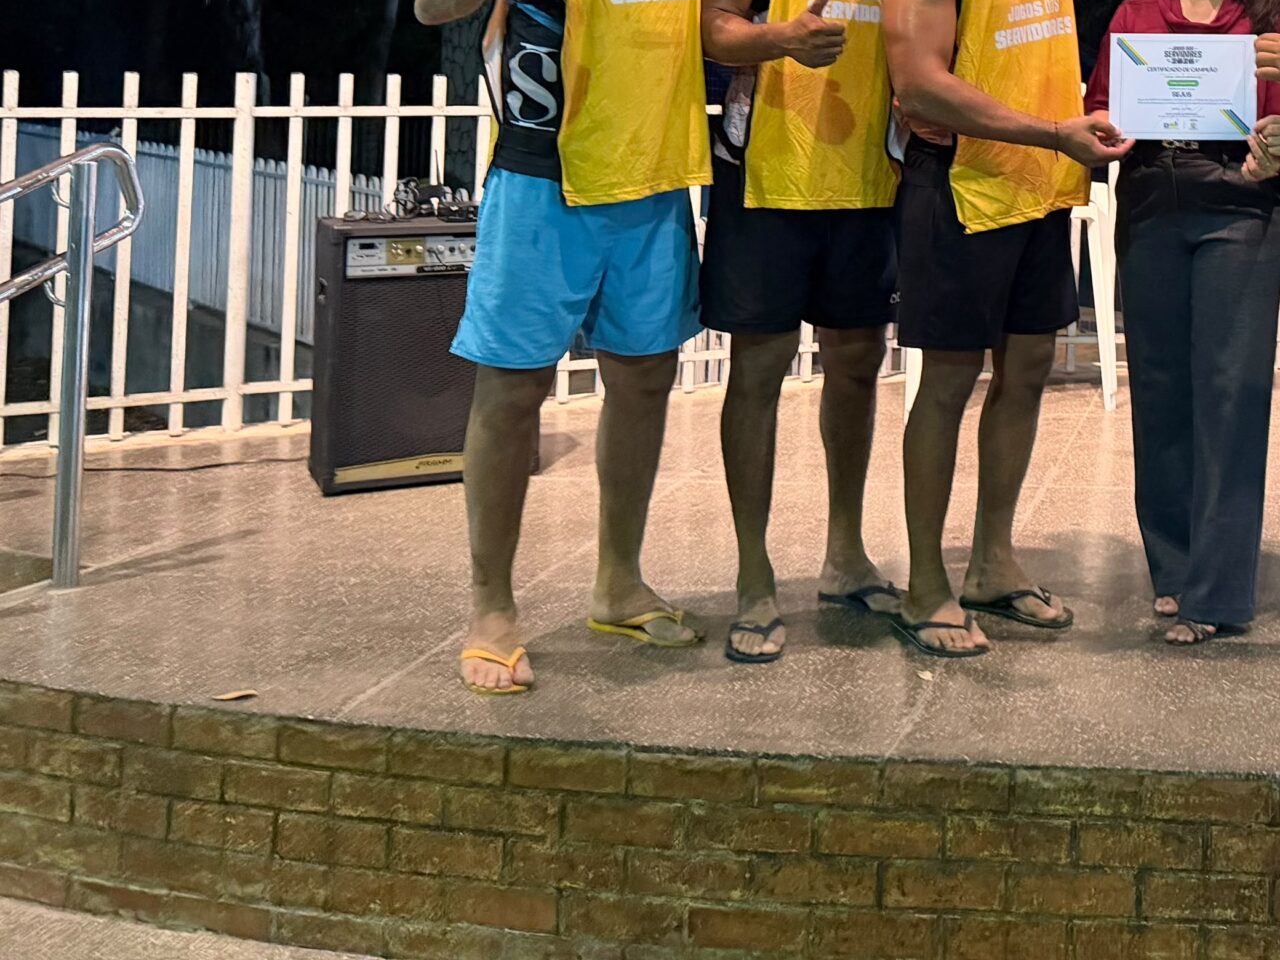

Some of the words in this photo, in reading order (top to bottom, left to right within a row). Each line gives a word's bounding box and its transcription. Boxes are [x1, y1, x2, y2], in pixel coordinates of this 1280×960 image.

[807, 0, 881, 22] ERVIDO
[1008, 0, 1044, 22] JOGOS
[995, 15, 1072, 49] SERVIDORES
